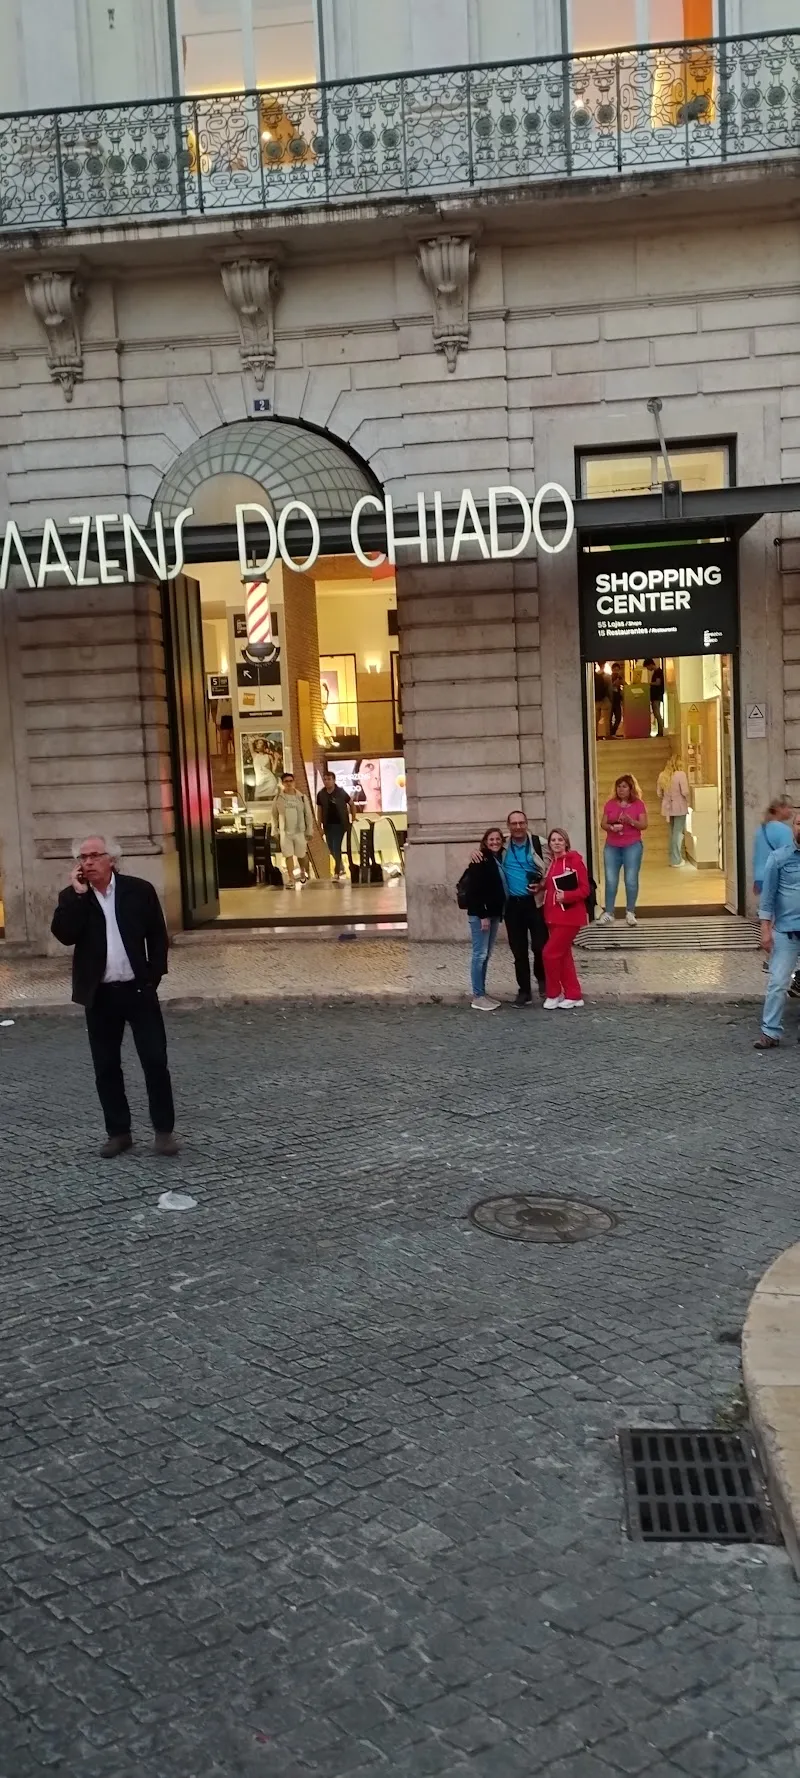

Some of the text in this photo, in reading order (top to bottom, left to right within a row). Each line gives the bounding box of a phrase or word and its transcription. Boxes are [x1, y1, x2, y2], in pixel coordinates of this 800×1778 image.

[259, 400, 265, 411] 2
[235, 500, 321, 577] DO
[350, 482, 575, 568] CHIADO
[595, 565, 722, 593] SHOPPING
[596, 590, 692, 615] CENTER
[607, 620, 624, 628] Lojas
[606, 628, 648, 636] Restaurantes
[212, 678, 218, 686] 5
